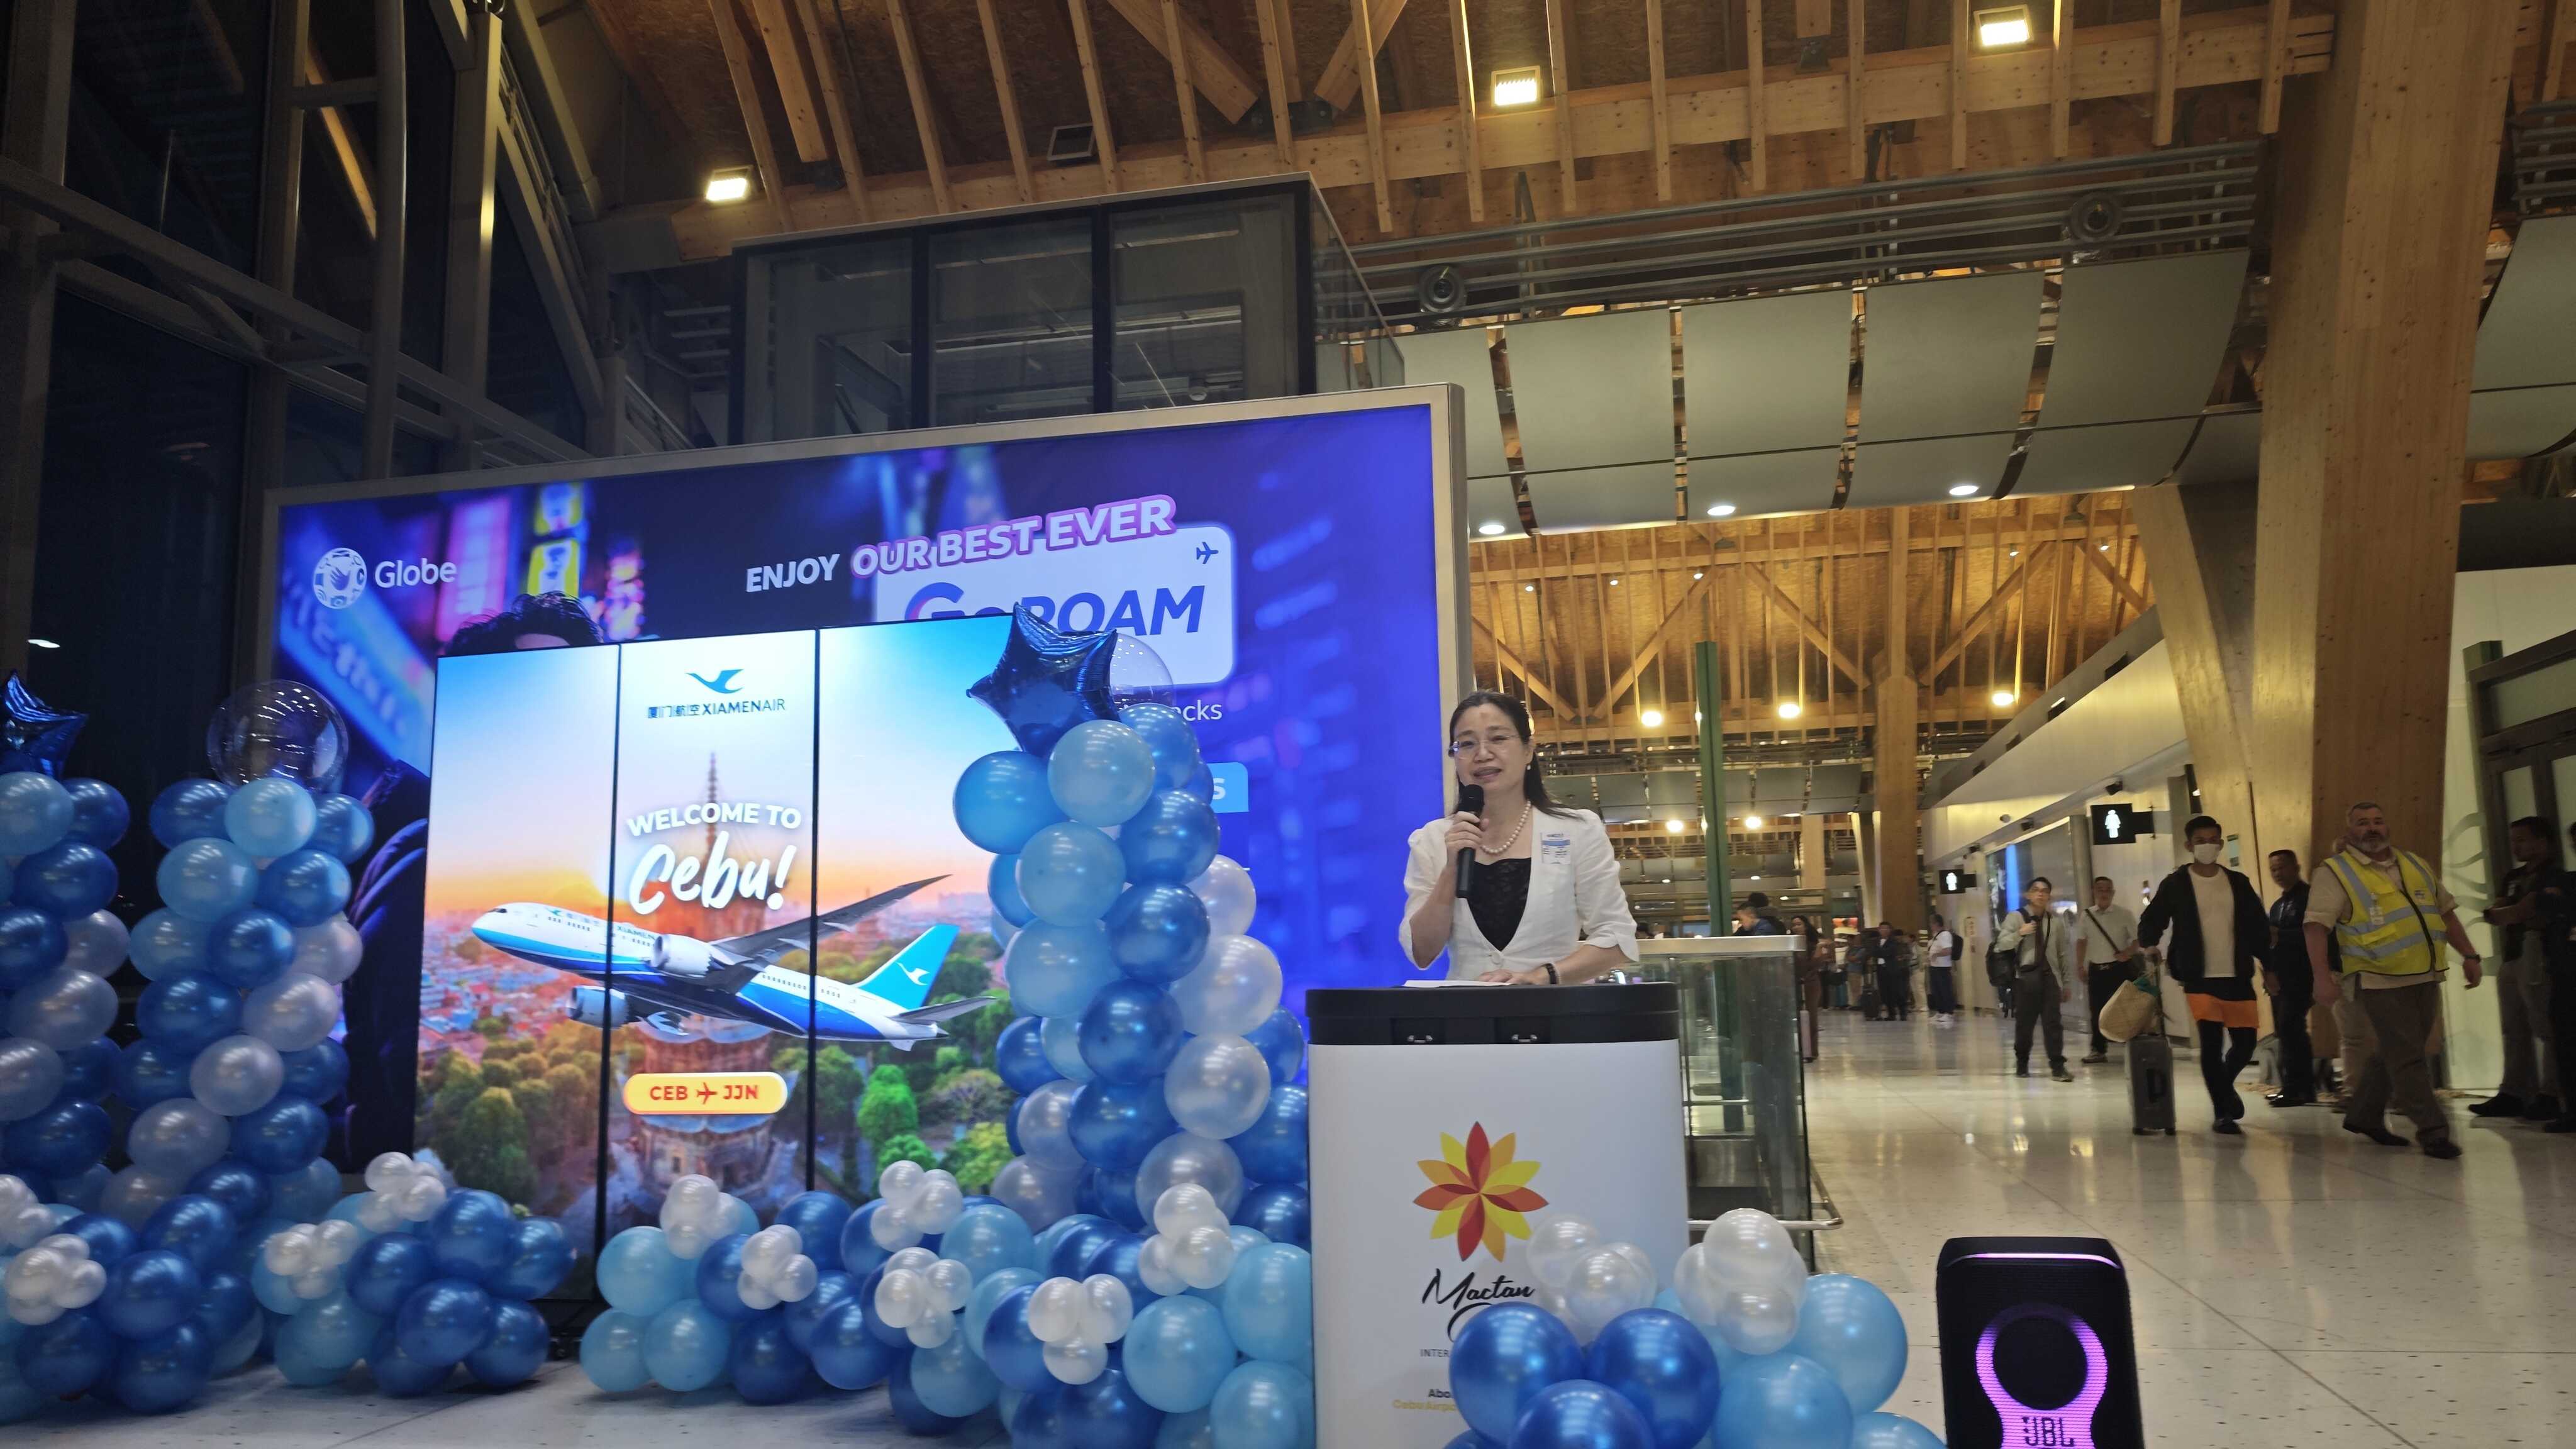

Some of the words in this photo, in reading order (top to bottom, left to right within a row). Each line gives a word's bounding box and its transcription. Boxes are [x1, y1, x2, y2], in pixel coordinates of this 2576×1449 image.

[745, 553, 840, 592] ENJOY
[852, 538, 930, 575] OUR
[940, 519, 1041, 565] BEST
[1048, 499, 1174, 547] EVER
[374, 557, 458, 589] Globe
[904, 582, 1206, 636] GROAM
[702, 698, 786, 716] XIAMENAIR
[1173, 699, 1223, 721] cks
[626, 802, 761, 836] WELCOME
[765, 804, 802, 830] TO
[629, 830, 797, 915] Cebu!
[650, 1085, 689, 1101] CEB
[723, 1084, 758, 1100] JJN
[1421, 1267, 1536, 1311] Mactan
[1419, 1348, 1450, 1358] INTER
[1428, 1388, 1452, 1399] Abo
[2022, 1416, 2075, 1447] JBL
